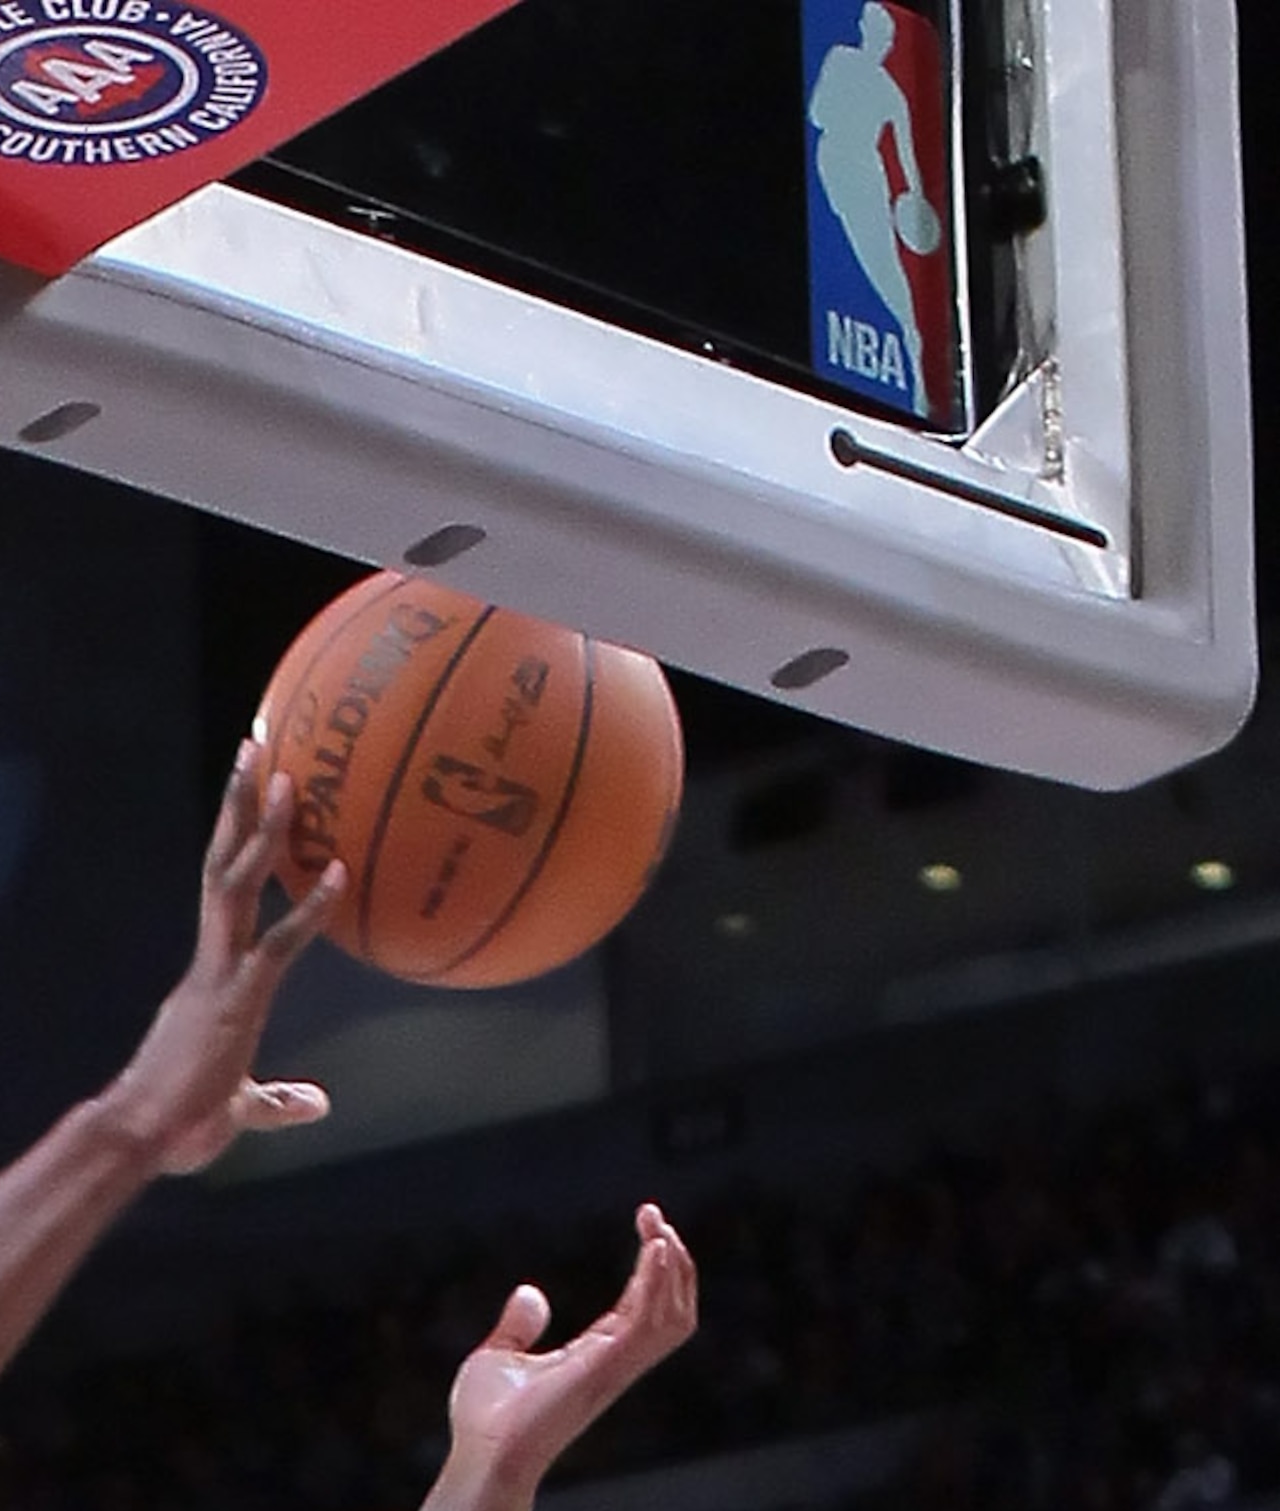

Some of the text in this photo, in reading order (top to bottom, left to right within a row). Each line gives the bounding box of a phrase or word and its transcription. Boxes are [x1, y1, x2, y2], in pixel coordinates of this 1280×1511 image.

[45, 0, 153, 22] CLUB
[11, 40, 154, 116] AAA
[169, 12, 259, 131] CALIFORNIA
[826, 310, 908, 391] NBA
